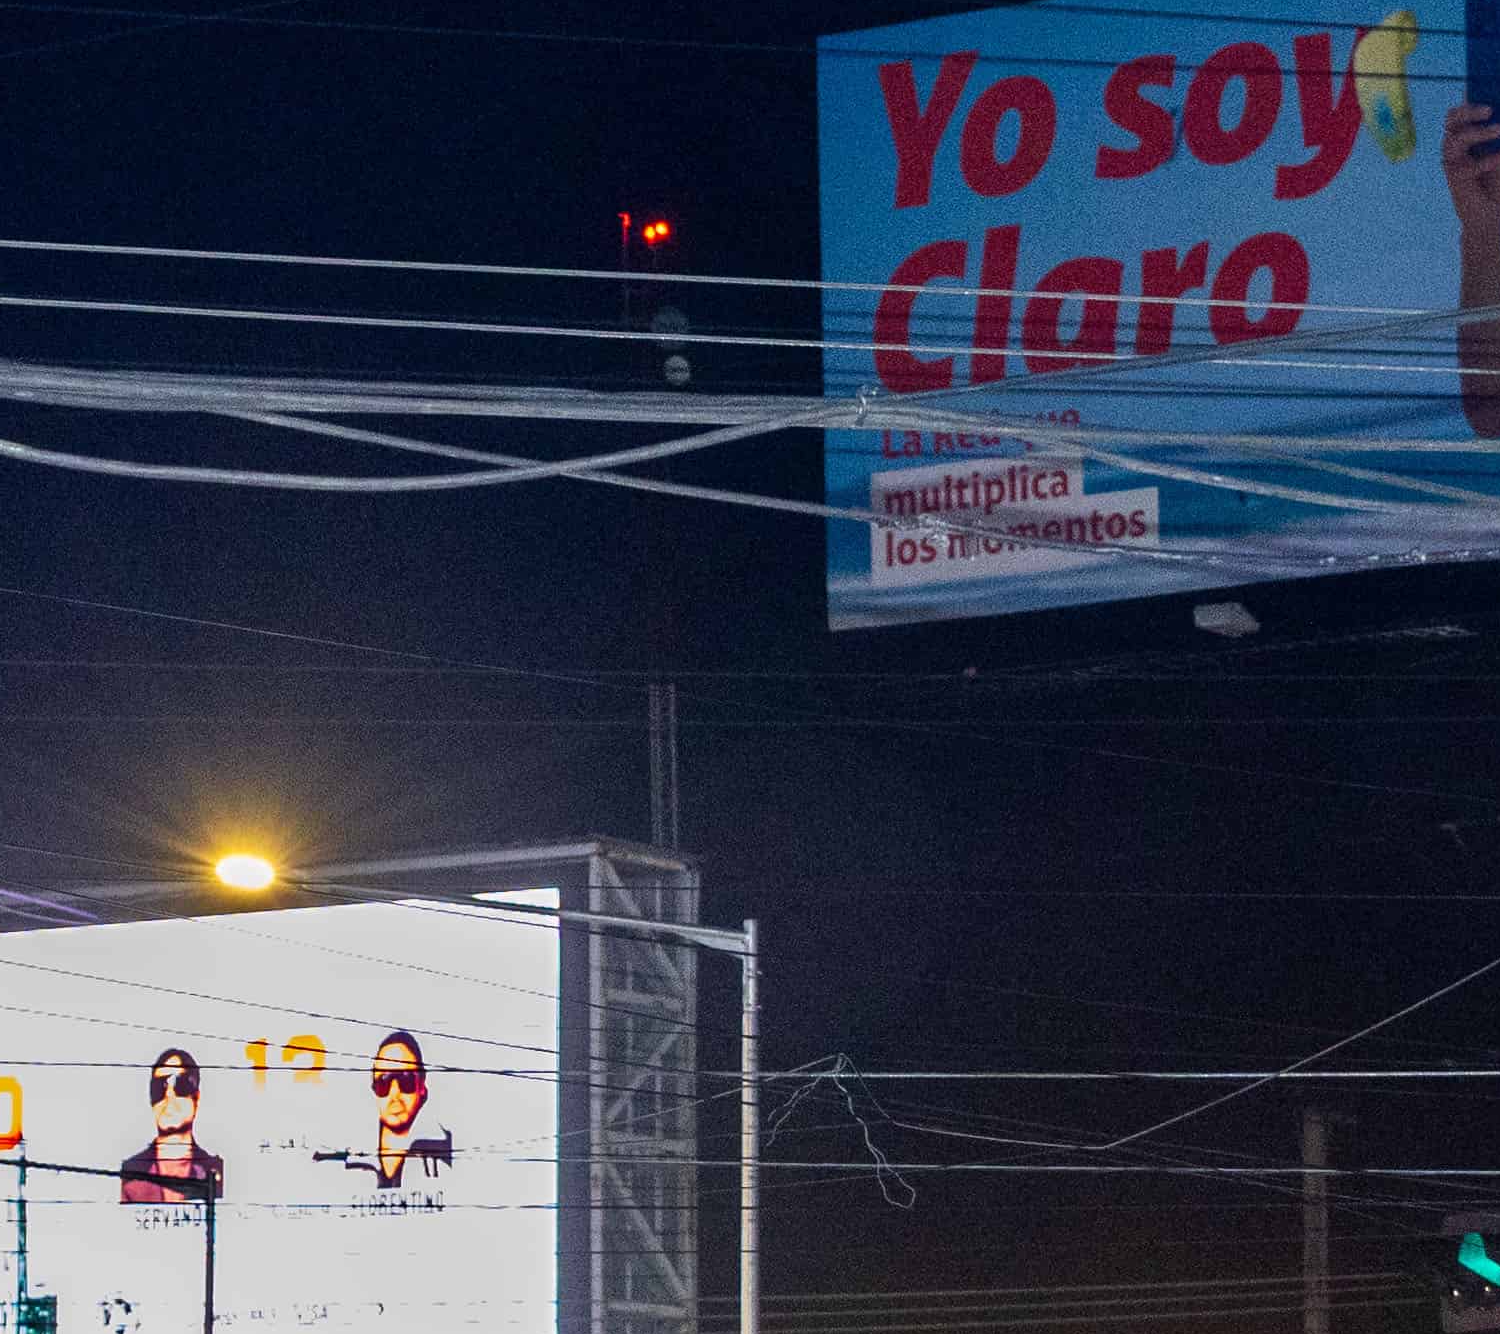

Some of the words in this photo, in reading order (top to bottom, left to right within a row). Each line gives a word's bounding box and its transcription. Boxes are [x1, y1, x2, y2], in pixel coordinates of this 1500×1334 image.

[878, 50, 1058, 210] Yo
[1094, 25, 1368, 201] soy
[872, 223, 1311, 394] Claro
[883, 466, 1069, 516] multiplica
[885, 530, 937, 568] los
